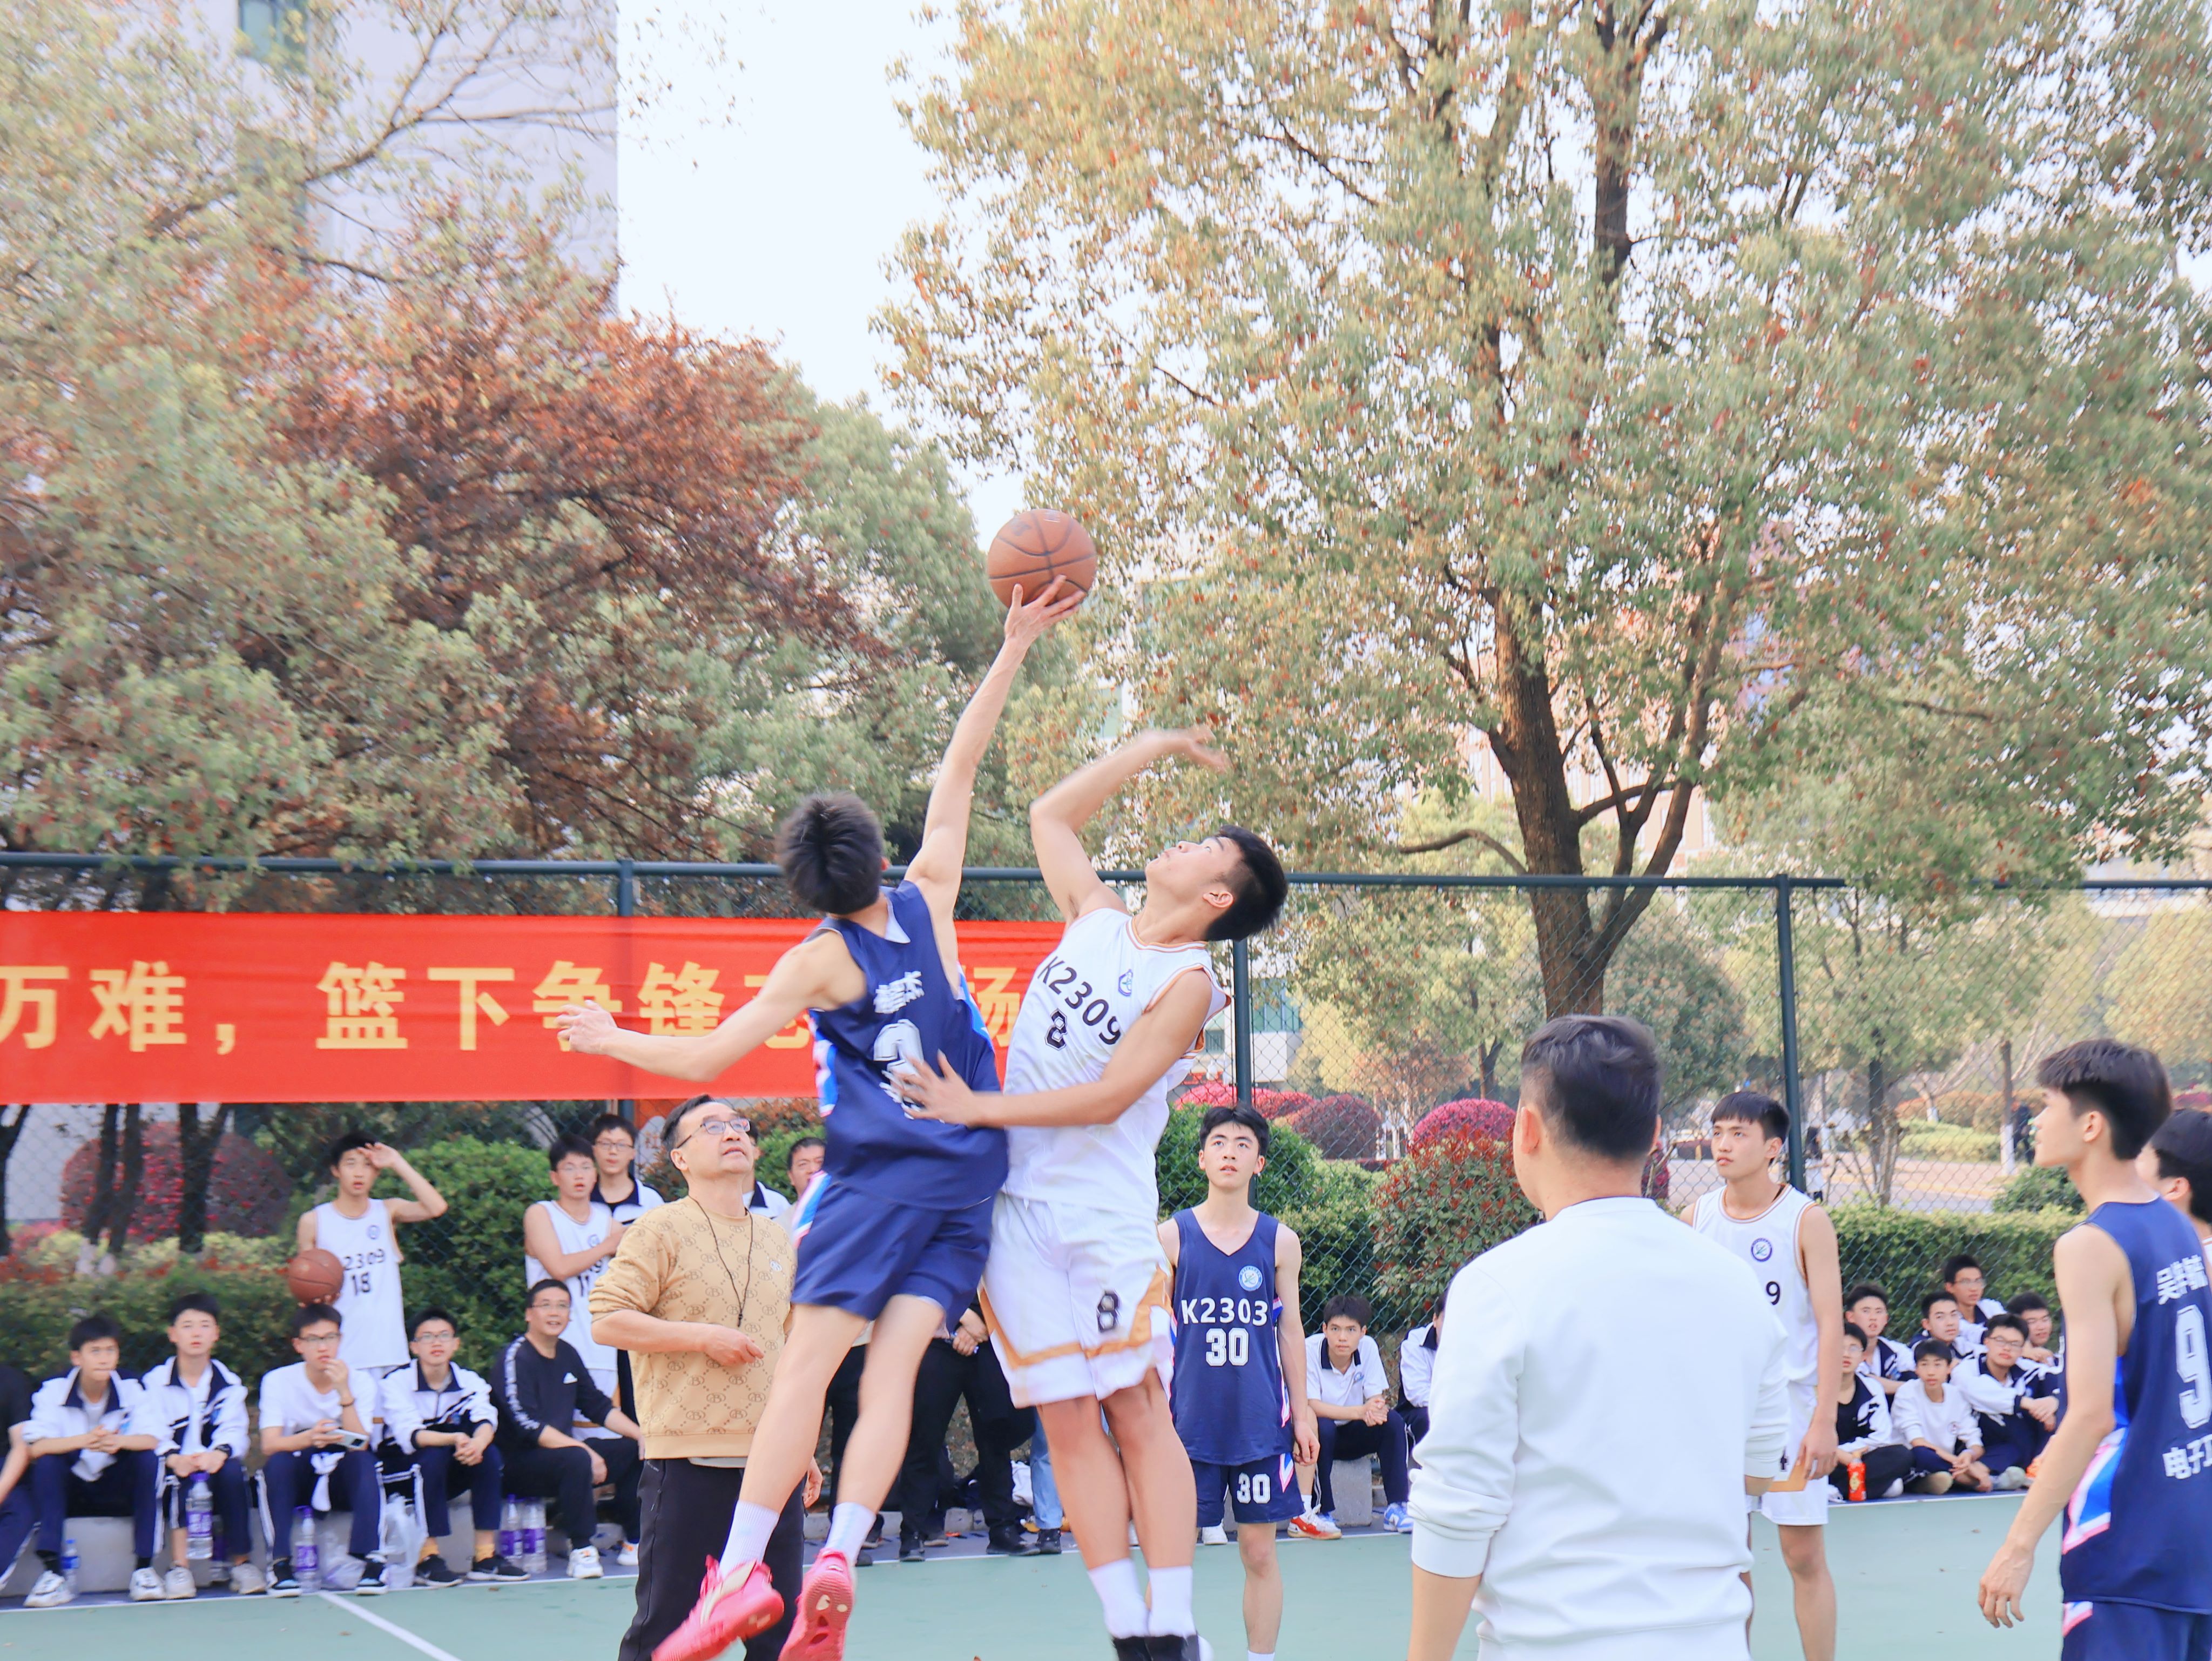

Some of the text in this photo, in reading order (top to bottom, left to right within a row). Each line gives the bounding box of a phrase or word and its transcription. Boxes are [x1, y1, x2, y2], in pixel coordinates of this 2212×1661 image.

[1037, 956, 1122, 1046] K2309
[1044, 1008, 1068, 1051] 8
[343, 1248, 386, 1270] 2309
[1096, 1290, 1119, 1333] 8
[1181, 1297, 1268, 1326] K2303
[1766, 1281, 1781, 1306] 9
[1206, 1328, 1249, 1367] 30
[2175, 1304, 2212, 1429] 9
[1237, 1472, 1271, 1504] 30
